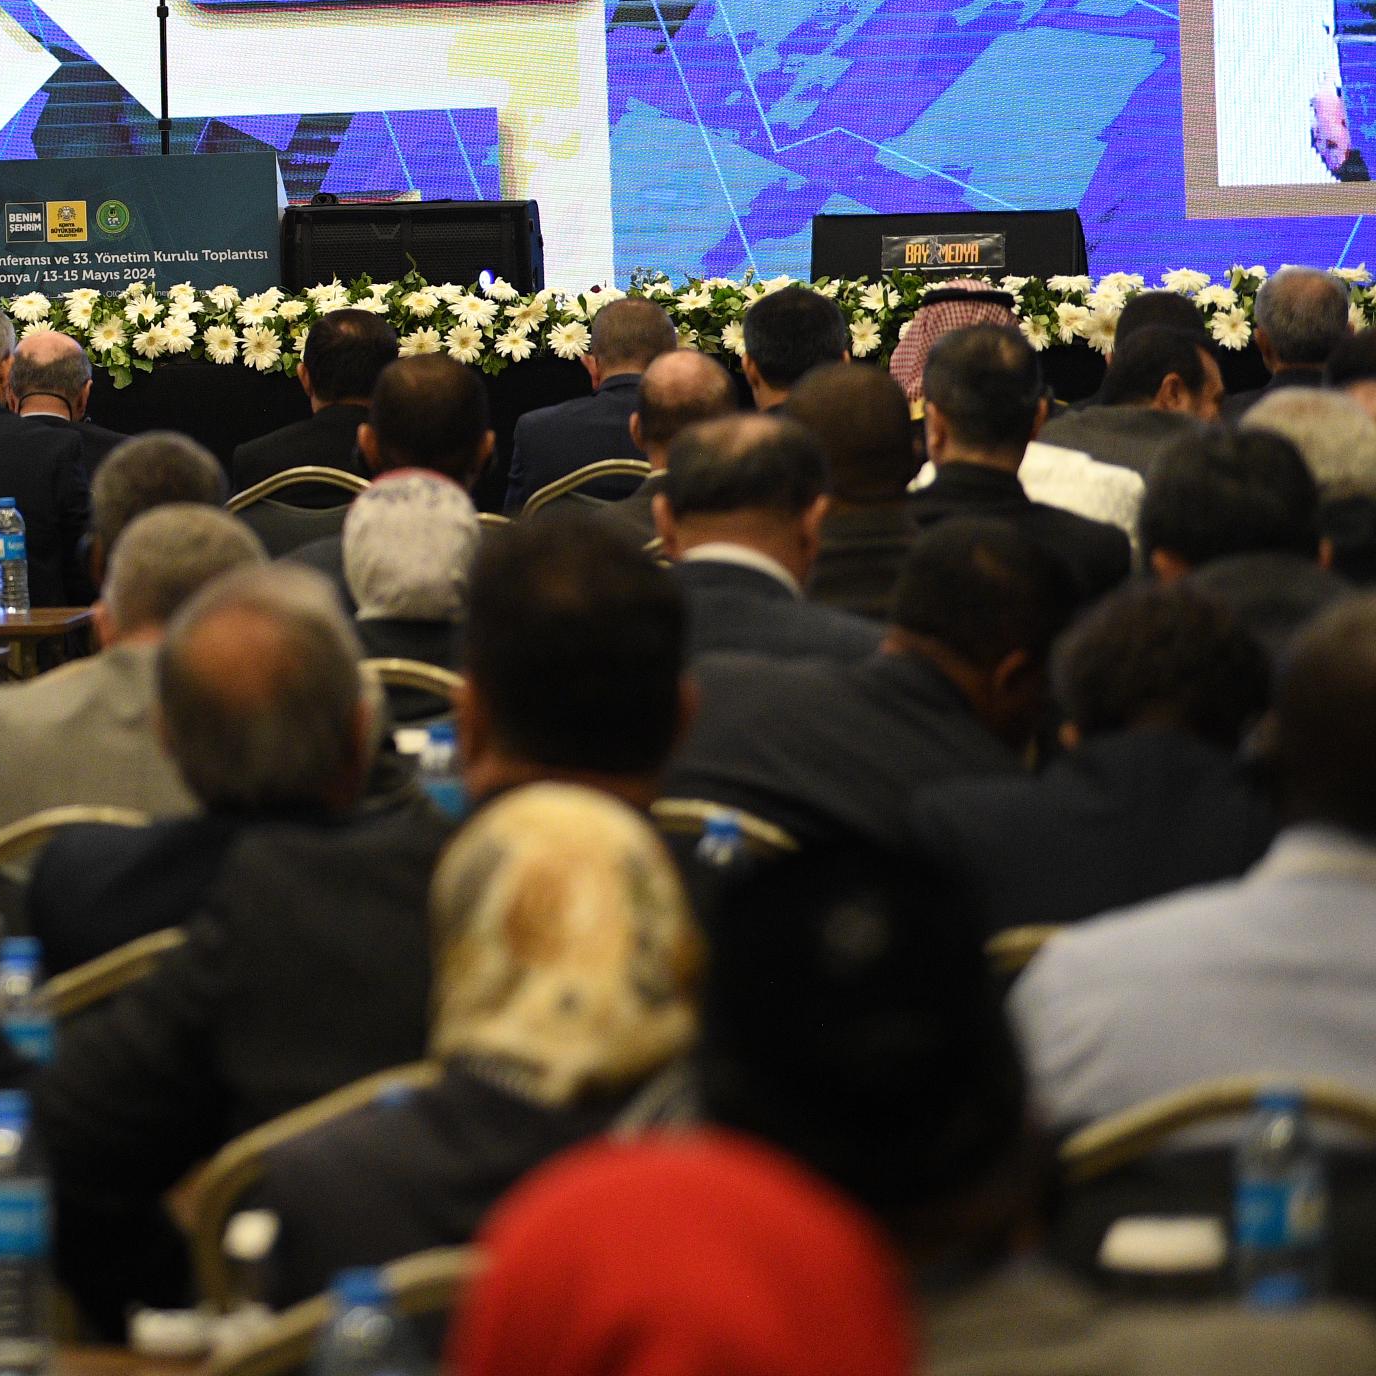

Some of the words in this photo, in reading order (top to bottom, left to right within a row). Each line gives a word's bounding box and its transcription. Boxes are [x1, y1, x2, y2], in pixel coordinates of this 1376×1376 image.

[54, 256, 69, 264] ve
[73, 253, 92, 264] 33.
[95, 252, 150, 264] Yönetim
[154, 250, 198, 262] Kurulu
[202, 249, 269, 263] Toplantısı
[905, 243, 929, 264] BAY
[939, 242, 980, 264] MEDYA
[34, 270, 39, 283] /
[42, 269, 79, 281] 13-15
[82, 269, 120, 283] Mayıs
[123, 268, 156, 279] 2024
